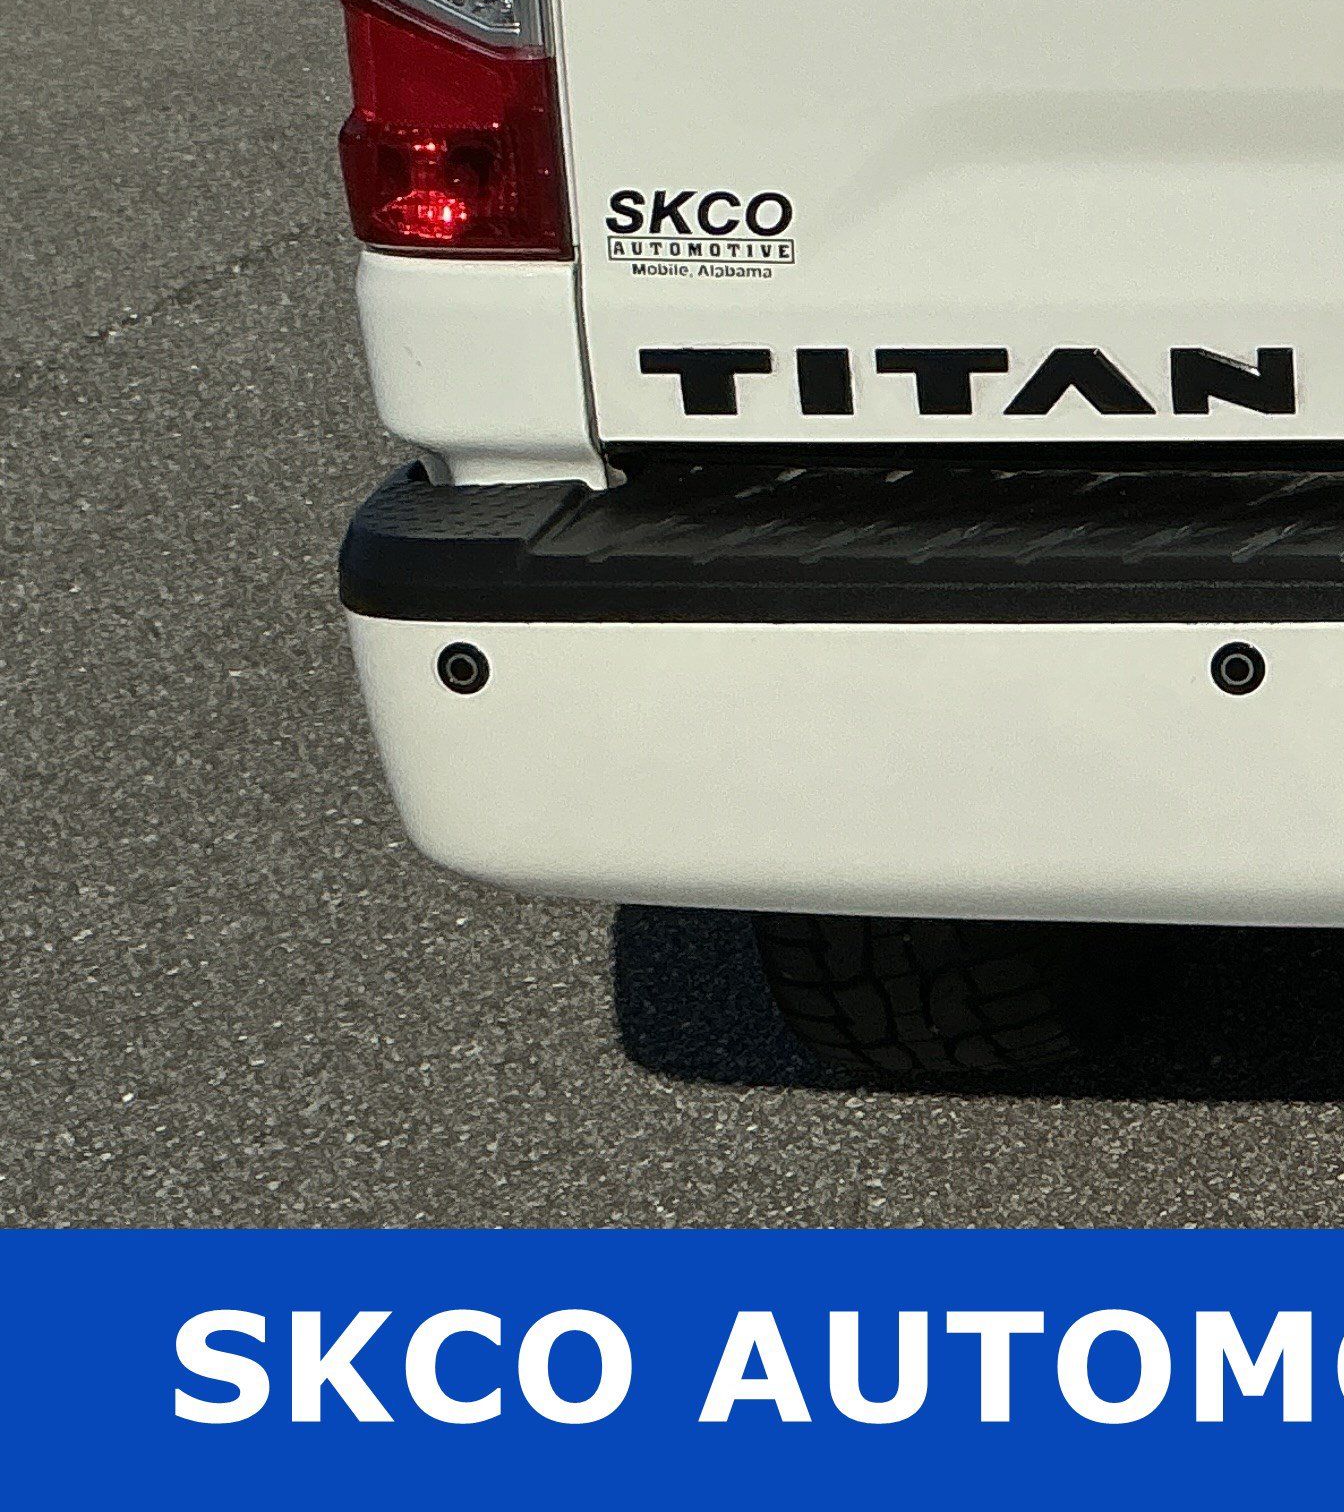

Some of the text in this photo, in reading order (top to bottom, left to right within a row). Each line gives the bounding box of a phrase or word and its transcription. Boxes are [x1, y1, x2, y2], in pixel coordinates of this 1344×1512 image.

[605, 190, 793, 237] SKCO
[612, 241, 791, 259] AUTOMOTIVE
[632, 263, 773, 279] Mobile, Alabama
[639, 347, 1296, 415] TITAN
